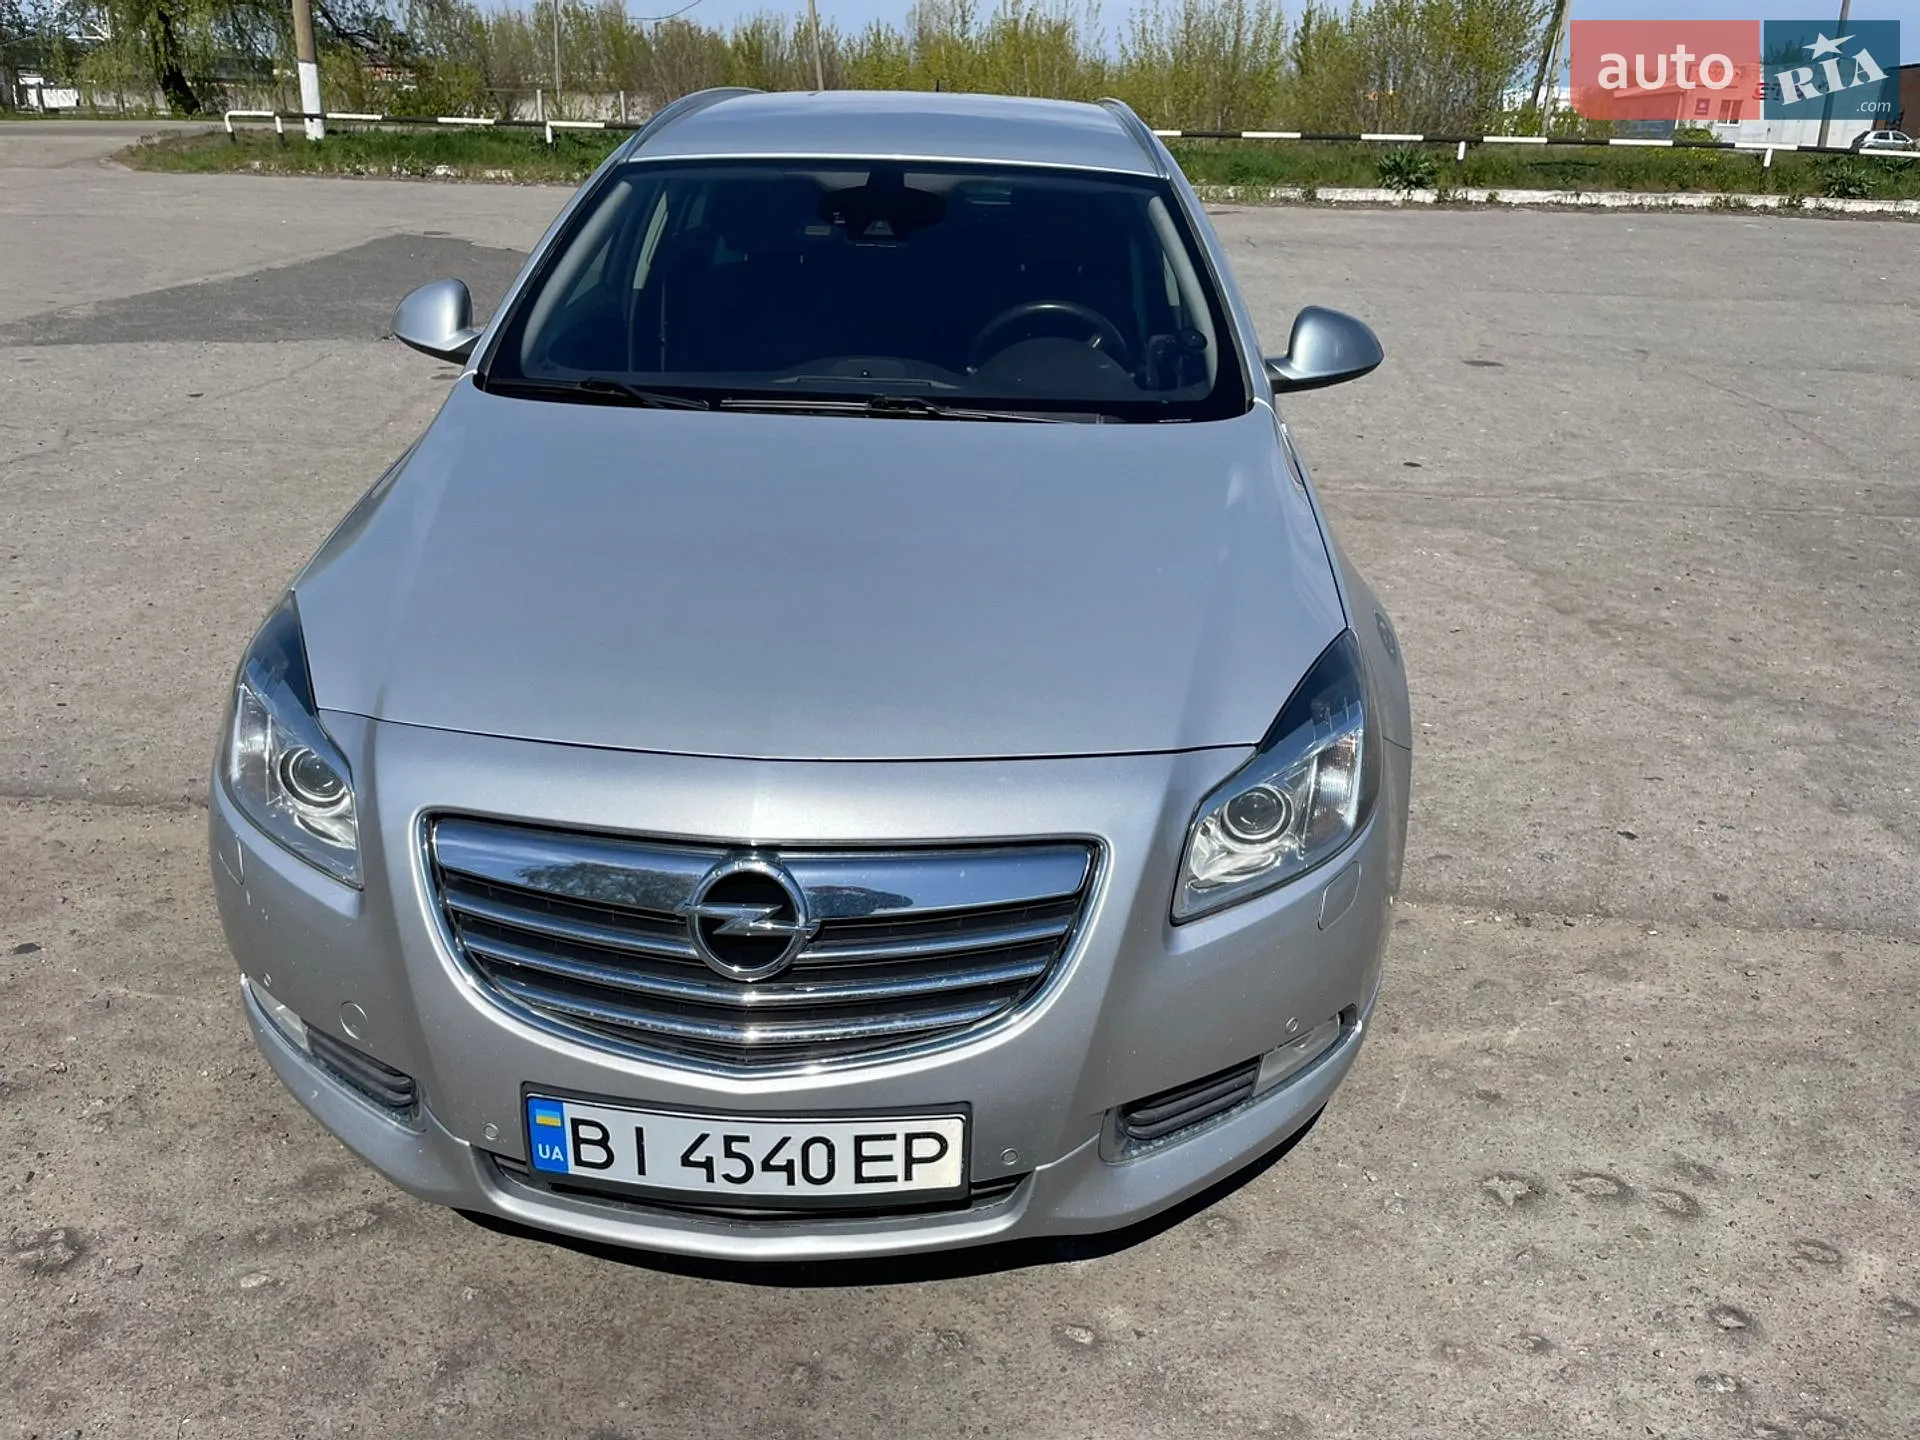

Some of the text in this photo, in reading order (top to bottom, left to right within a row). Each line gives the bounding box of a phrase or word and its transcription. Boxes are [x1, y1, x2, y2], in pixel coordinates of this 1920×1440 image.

[538, 1143, 564, 1161] UA
[570, 1117, 949, 1186] BI 4540 EP
